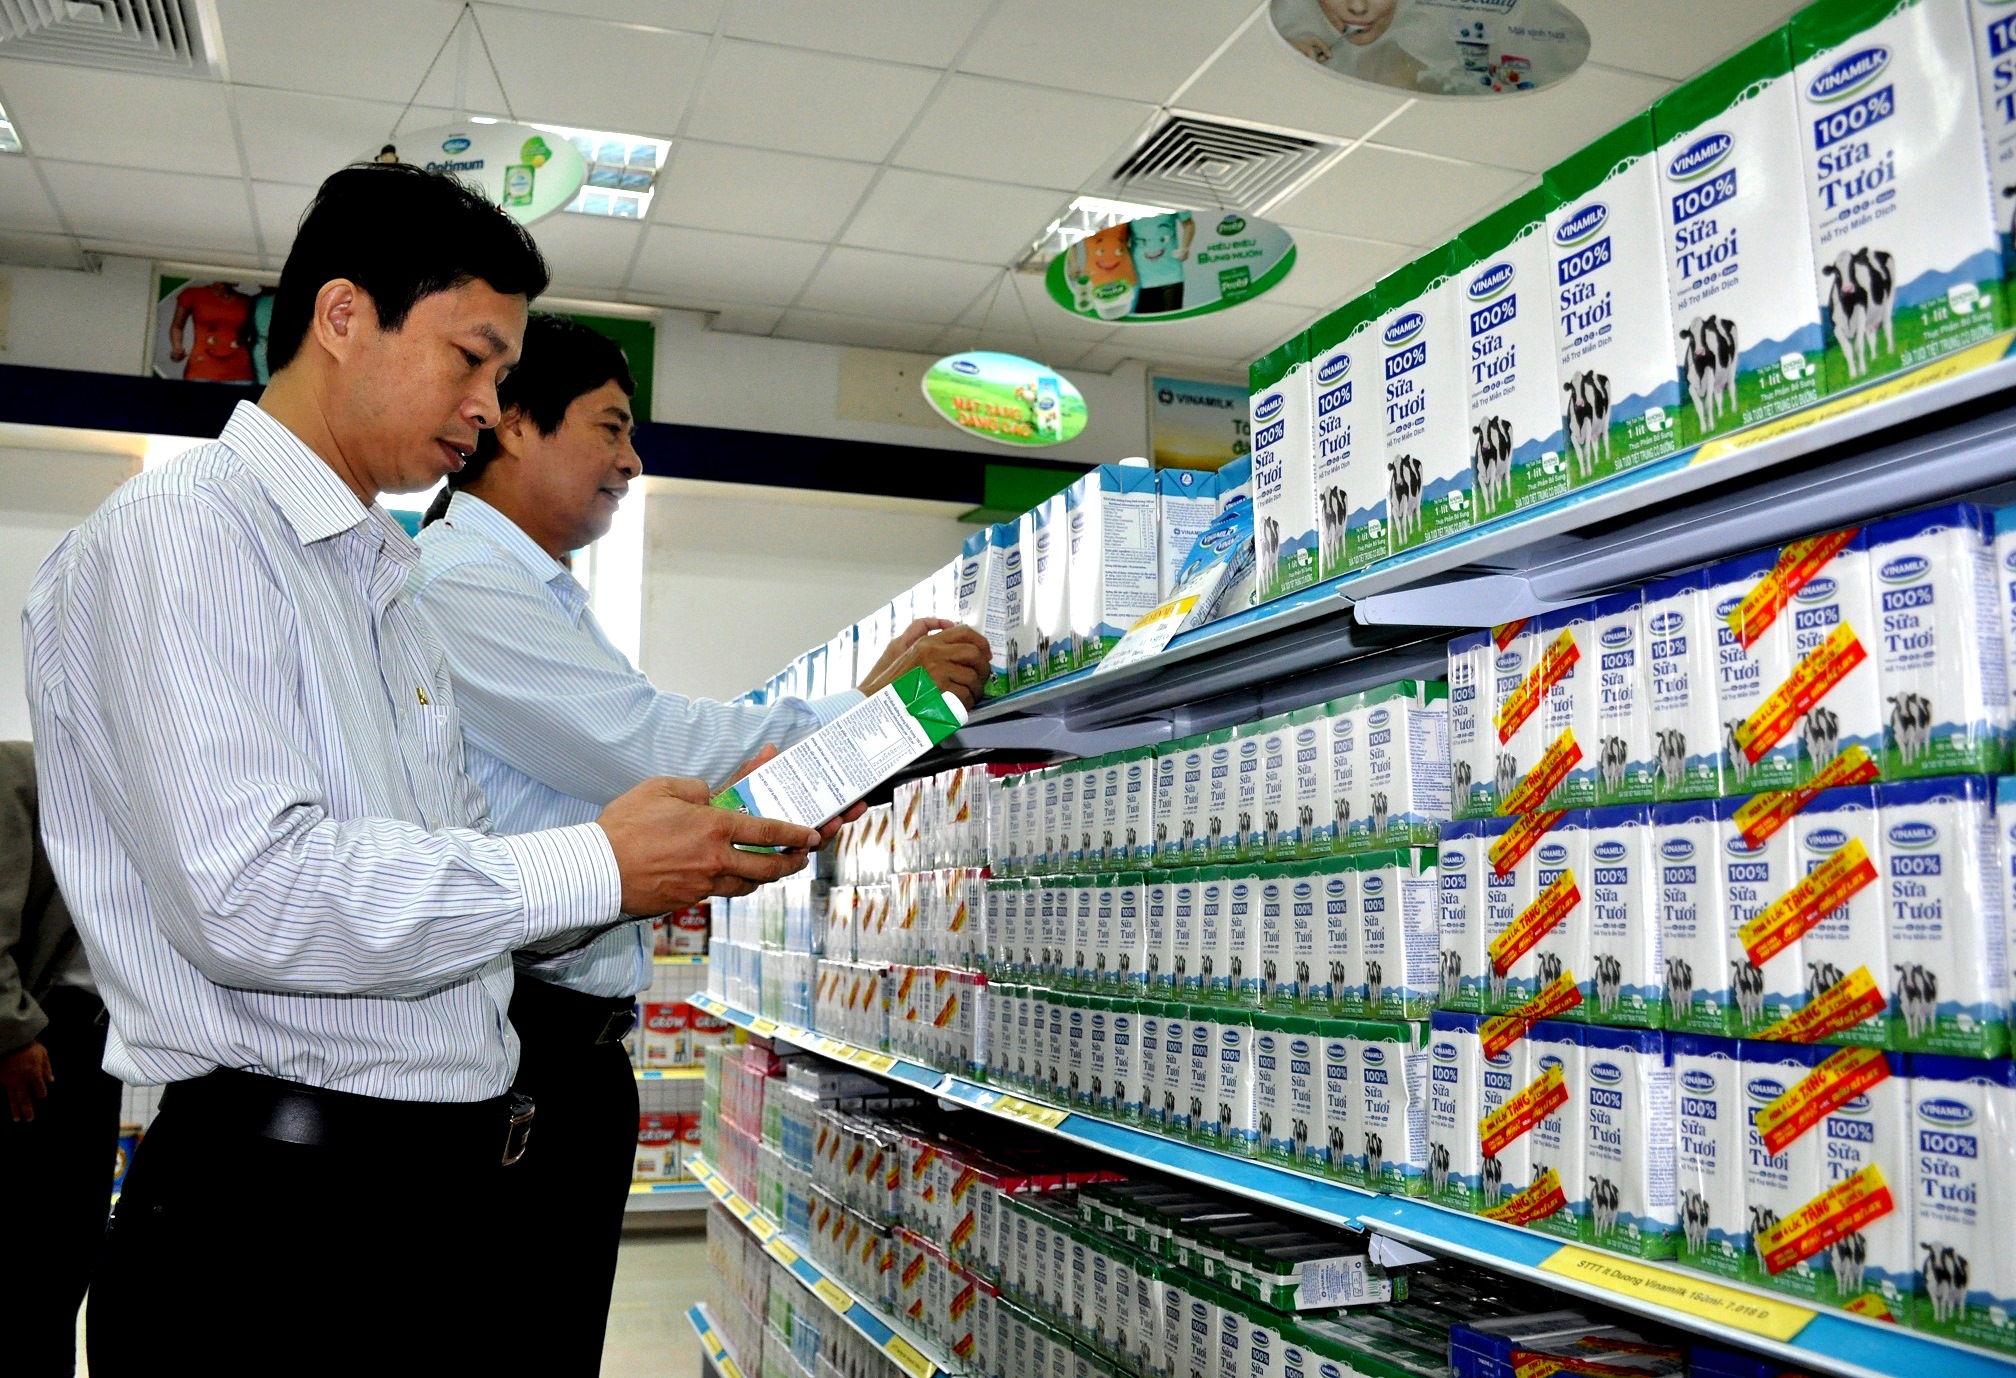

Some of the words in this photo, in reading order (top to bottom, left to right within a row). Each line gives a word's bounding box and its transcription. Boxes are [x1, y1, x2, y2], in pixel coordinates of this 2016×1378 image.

[1814, 49, 1884, 93] VINAMILK
[1818, 88, 1890, 144] 100%
[1673, 137, 1728, 172] VINAMILK
[1817, 142, 1871, 181] Sữa
[1818, 150, 1896, 211] Tươi
[1675, 174, 1734, 219] 100%
[1559, 208, 1604, 238] VINAMILK
[1675, 219, 1718, 253] Sữa
[1676, 228, 1739, 280] Tươi
[1561, 242, 1609, 285] 100%
[1472, 266, 1511, 293] VINAMILK
[1560, 283, 1595, 311] Sữa
[1473, 299, 1514, 333] 100%
[1561, 291, 1612, 337] Tươi
[1921, 314, 1928, 325] 1
[1386, 315, 1422, 339] VINAMILK
[1471, 334, 1503, 361] Sữa
[1319, 357, 1349, 378] VINAMILK
[1387, 346, 1424, 377] 100%
[1472, 344, 1516, 385] Tươi
[1386, 378, 1413, 403] Sữa
[1759, 378, 1766, 389] 1
[1256, 397, 1283, 416] VINAMILK
[1320, 386, 1351, 414] 100%
[1387, 388, 1425, 425] Tươi
[1256, 422, 1283, 448] 100%
[1318, 415, 1342, 438] Sữa
[1627, 428, 1633, 439] 1
[1319, 425, 1351, 458] Tươi
[1255, 449, 1274, 471] Sữa
[1256, 460, 1282, 490] Tươi
[1882, 561, 1927, 577] VINAMILK
[1884, 586, 1932, 610] 100%
[1797, 608, 1838, 628] 100%
[1883, 614, 1919, 632] Sữa
[1603, 631, 1631, 642] VINAMILK
[1884, 626, 1934, 653] Tươi
[1603, 653, 1633, 668] 100%
[1601, 673, 1624, 687] Sữa
[1602, 683, 1633, 703] Tươi
[1369, 712, 1387, 722] VINAMILK
[1370, 731, 1390, 744] 100%
[1369, 748, 1385, 760] Sữa
[1370, 757, 1391, 774] Tươi
[1891, 829, 1934, 839] VINAMILK
[1595, 846, 1624, 855] VINAMILK
[1662, 843, 1693, 854] VINAMILK
[1893, 858, 1939, 874] 100%
[1595, 870, 1626, 883] 100%
[1665, 869, 1695, 883] 100%
[1594, 888, 1618, 902] Sữa
[1663, 888, 1687, 902] Sữa
[1892, 881, 1926, 898] Sữa
[1365, 899, 1384, 911] 100%
[1595, 903, 1627, 920] Tươi
[1663, 903, 1696, 921] Tươi
[1893, 899, 1942, 920] Tươi
[1364, 915, 1379, 927] Sữa
[1365, 927, 1385, 941] Tươi
[1364, 1050, 1383, 1058] VINAMILK
[1434, 1047, 1456, 1056] VINAMILK
[1365, 1071, 1387, 1083] 100%
[1433, 1067, 1457, 1082] 100%
[1592, 1068, 1621, 1079] VINAMILK
[1683, 1076, 1714, 1087] VINAMILK
[1365, 1086, 1383, 1098] Sữa
[1432, 1083, 1450, 1097] Sữa
[1592, 1090, 1621, 1107] 100%
[1365, 1099, 1390, 1114] Tươi
[1432, 1097, 1456, 1114] Tươi
[1683, 1101, 1716, 1118] 100%
[1921, 1104, 1970, 1117] VINAMILK
[1590, 1109, 1611, 1125] Sữa
[1591, 1124, 1621, 1145] Tươi
[1681, 1119, 1706, 1136] Sữa
[1681, 1137, 1716, 1158] Tươi
[1922, 1134, 1975, 1156] 100%
[1921, 1157, 1960, 1178] Sữa
[1921, 1178, 1977, 1204] Tươi
[1577, 1259, 1604, 1273] STTT
[1609, 1270, 1643, 1286] Duong
[1643, 1278, 1687, 1297] Vinamilk
[1252, 1349, 1269, 1364] 100%
[1251, 1362, 1264, 1376] Sữa
